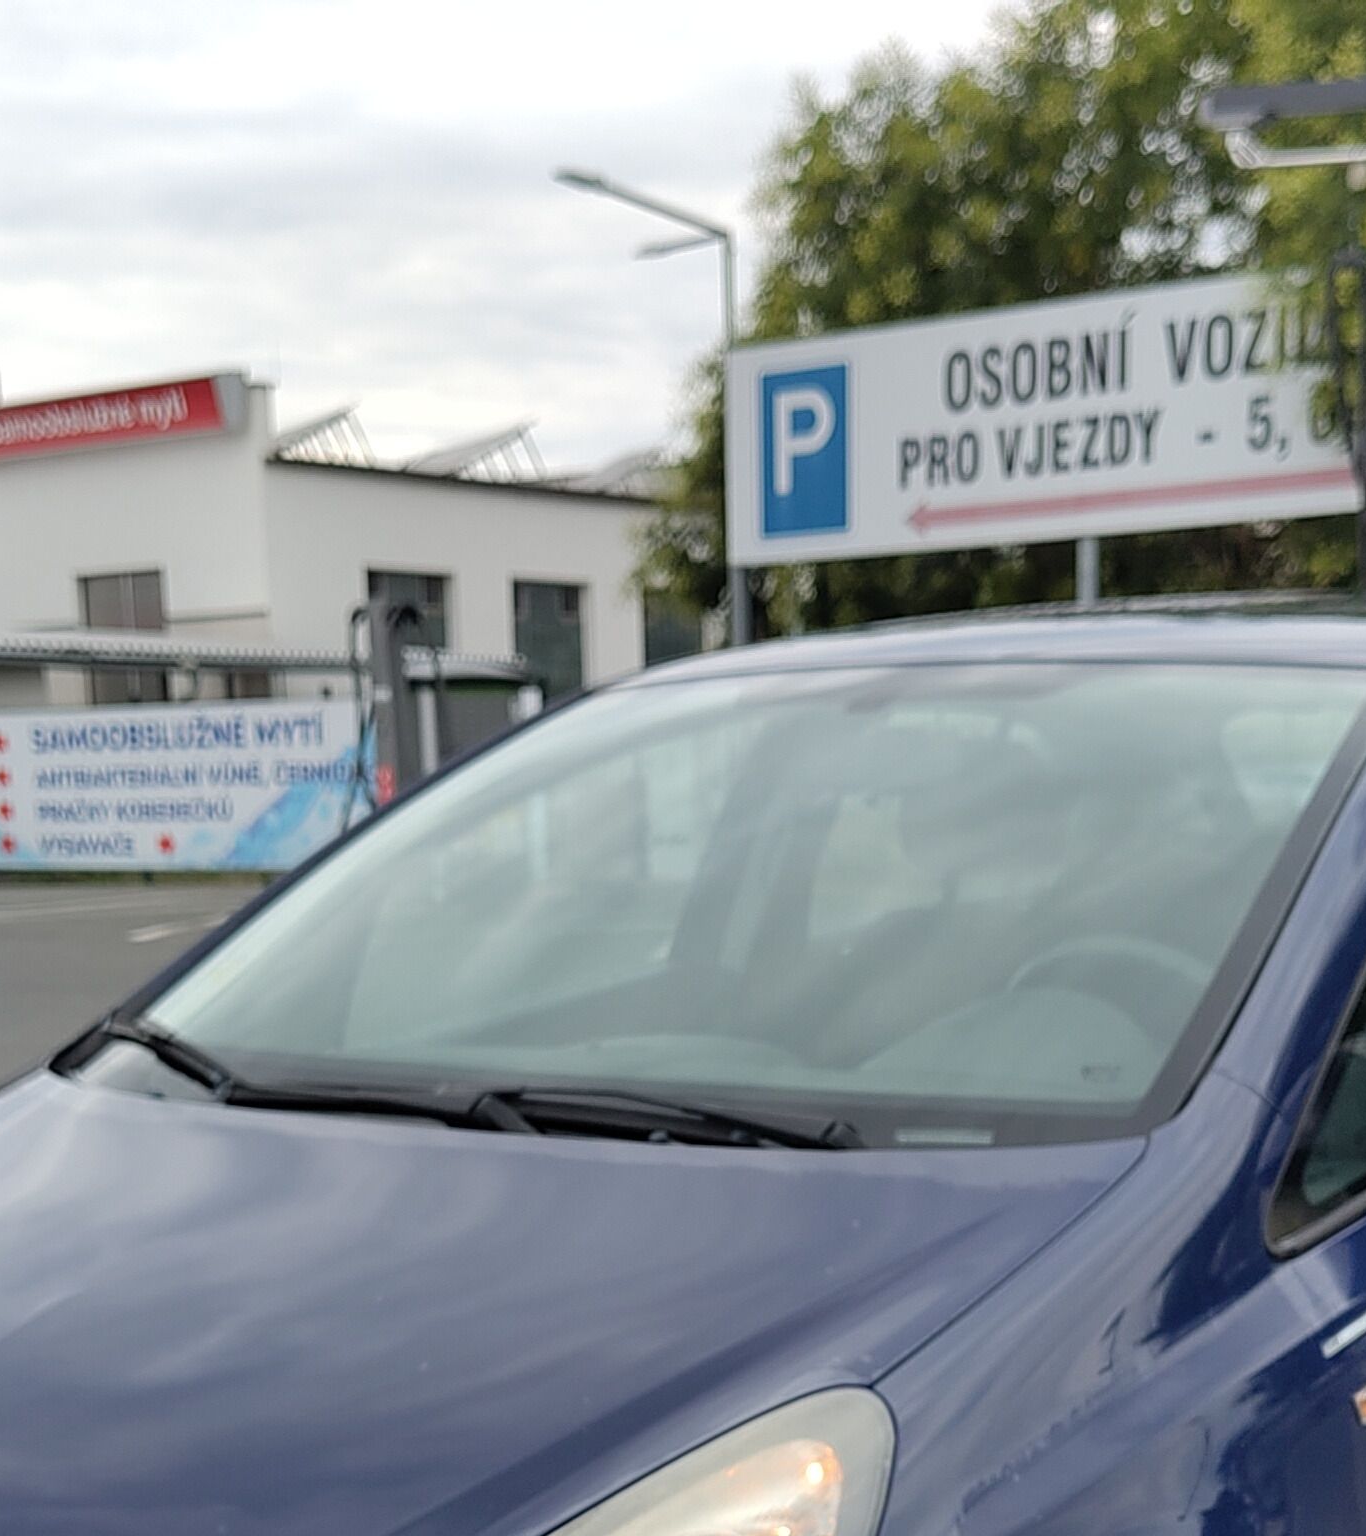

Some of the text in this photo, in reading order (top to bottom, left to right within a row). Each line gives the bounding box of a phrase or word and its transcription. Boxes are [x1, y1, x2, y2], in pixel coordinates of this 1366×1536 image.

[944, 312, 1135, 414] OSOBNÍ
[773, 388, 837, 497] P
[897, 432, 980, 490] PRO
[996, 408, 1164, 478] VJEZDY
[31, 706, 326, 752] SAMOOBSLUŽNÉ MYTÍ
